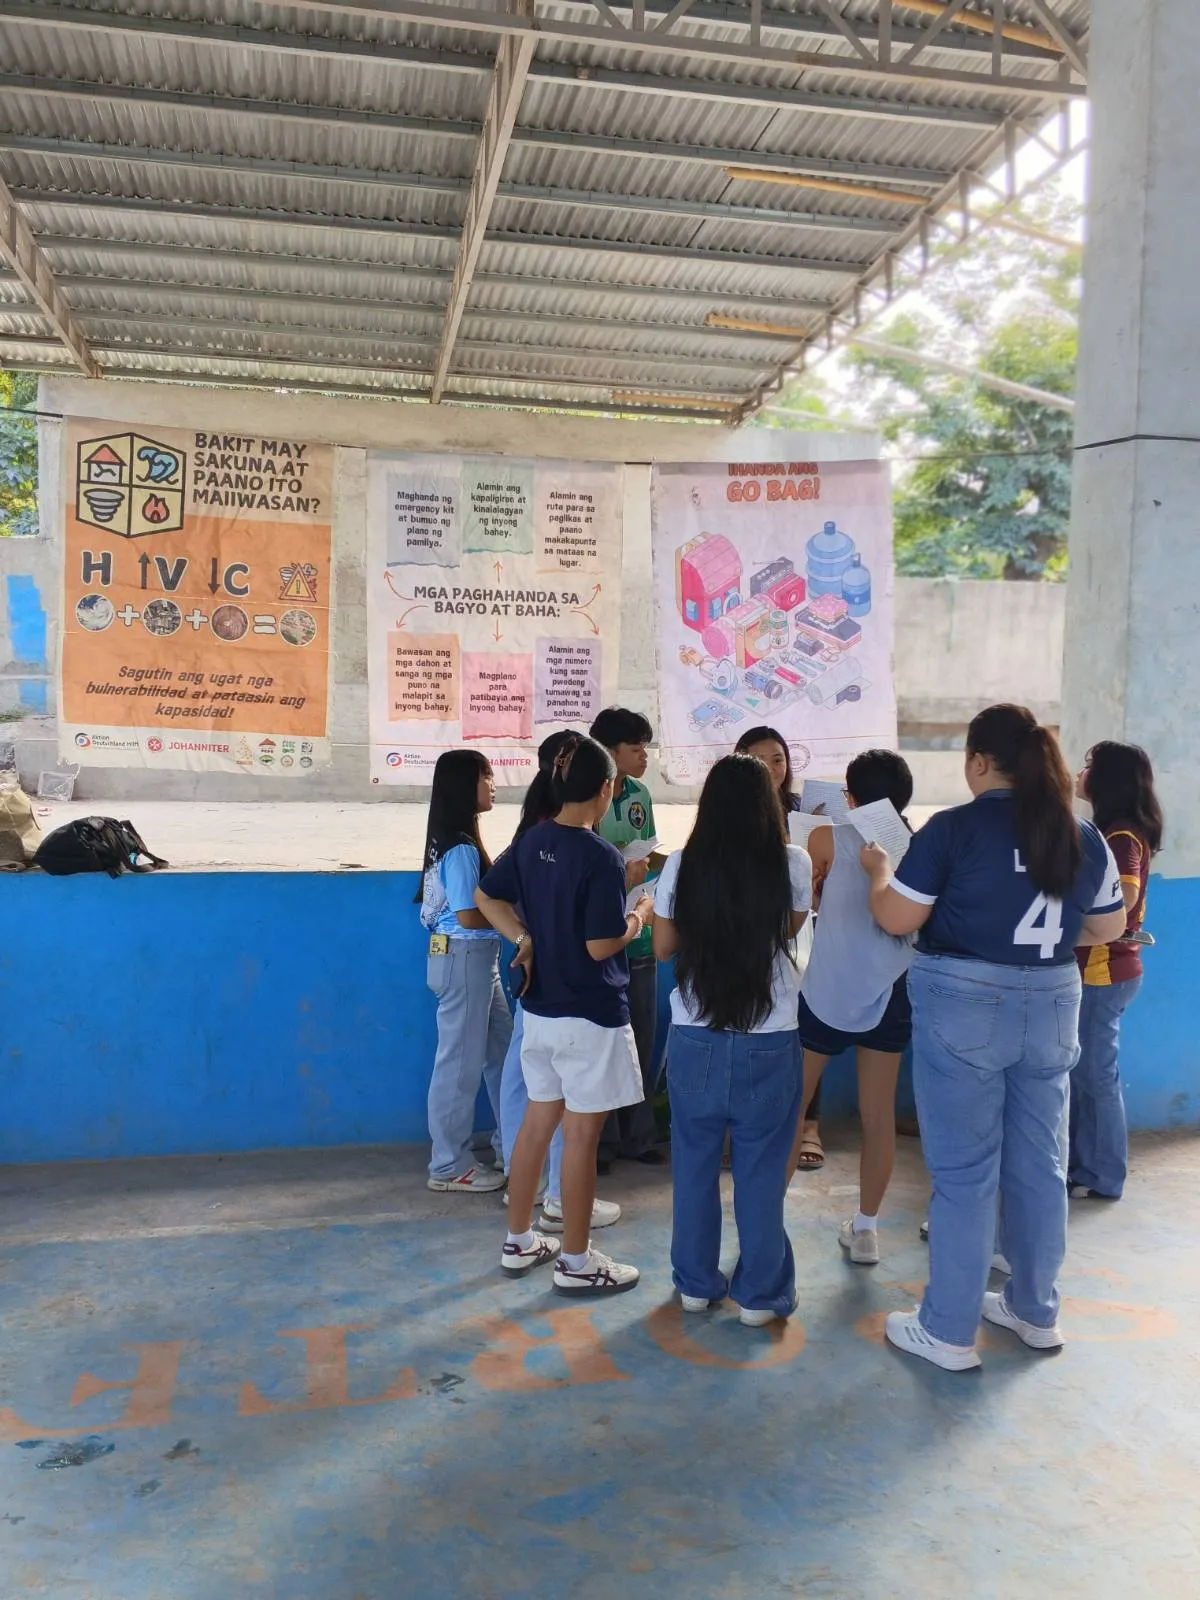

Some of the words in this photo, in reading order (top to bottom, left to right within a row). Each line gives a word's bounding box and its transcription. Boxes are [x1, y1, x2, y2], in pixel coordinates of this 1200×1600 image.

[195, 433, 255, 453] BAKIT
[261, 440, 307, 458] MAY
[194, 452, 276, 474] SAKUNA
[282, 461, 309, 477] AT
[193, 470, 263, 490] PAANO
[269, 478, 302, 493] ITO
[477, 482, 504, 491] Alamin
[506, 485, 521, 494] ang
[727, 481, 761, 502] GO
[766, 477, 820, 501] BAG!
[193, 489, 320, 513] MAIIWASAN?
[397, 491, 439, 502] Maghanda
[442, 496, 452, 505] ng
[471, 493, 514, 504] kapaligiran
[517, 496, 526, 504] at
[550, 491, 576, 500] Alamin
[579, 494, 593, 503] ang
[395, 504, 440, 515] emergency
[442, 505, 455, 514] kit
[473, 504, 523, 516] kinalalagyan
[546, 503, 563, 511] ruta
[566, 504, 584, 513] para
[410, 514, 438, 524] bumuo
[440, 518, 451, 527] ng
[479, 517, 489, 526] ng
[491, 517, 518, 528] inyong
[549, 514, 581, 523] paglikas
[407, 526, 429, 536] plano
[432, 529, 442, 538] ng
[484, 527, 512, 539] bahay.
[559, 527, 582, 535] paano
[407, 538, 442, 549] pamilya.
[544, 536, 596, 546] makakapunta
[556, 548, 584, 556] mataas
[560, 558, 581, 568] lugar.
[82, 551, 112, 585] H
[155, 556, 187, 591] V
[223, 563, 249, 596] C
[414, 586, 448, 599] MGA
[452, 587, 557, 603] PAGHAHANDA
[561, 592, 580, 604] SA
[434, 601, 487, 615] BAGYO
[491, 604, 510, 616] AT
[515, 604, 561, 617] BAHA:
[397, 647, 433, 656] Bawasan
[436, 650, 451, 658] ang
[549, 645, 574, 654] Alamin
[576, 648, 590, 656] ang
[395, 660, 413, 668] mga
[416, 659, 440, 667] dahon
[546, 657, 562, 665] mga
[395, 671, 419, 679] sanga
[422, 671, 432, 680] ng
[435, 672, 453, 680] mga
[479, 671, 517, 681] Magplano
[549, 667, 568, 676] kung
[118, 666, 173, 681] Sagutin
[178, 671, 204, 685] ang
[209, 674, 243, 687] ugat
[247, 677, 273, 689] nga
[552, 678, 585, 687] pwedeng
[408, 682, 427, 690] puno
[489, 684, 507, 692] para
[85, 682, 188, 699] bulnerabilidad
[192, 690, 209, 699] at
[212, 690, 274, 705] pataasin
[279, 695, 305, 710] ang
[402, 691, 433, 701] malapit
[471, 693, 508, 703] patibayin
[511, 695, 526, 703] ang
[545, 689, 580, 698] tumawag
[395, 701, 422, 712] inyong
[424, 702, 453, 713] bahay.
[469, 703, 496, 713] inyong
[498, 703, 526, 714] bahay.
[547, 698, 579, 707] panahon
[581, 700, 590, 708] ng
[155, 703, 235, 719] kapasidad!
[553, 709, 583, 717] sakuna.
[168, 741, 229, 753] JOHANNITER
[488, 758, 531, 767] HANNITER
[1013, 890, 1063, 959] 4
